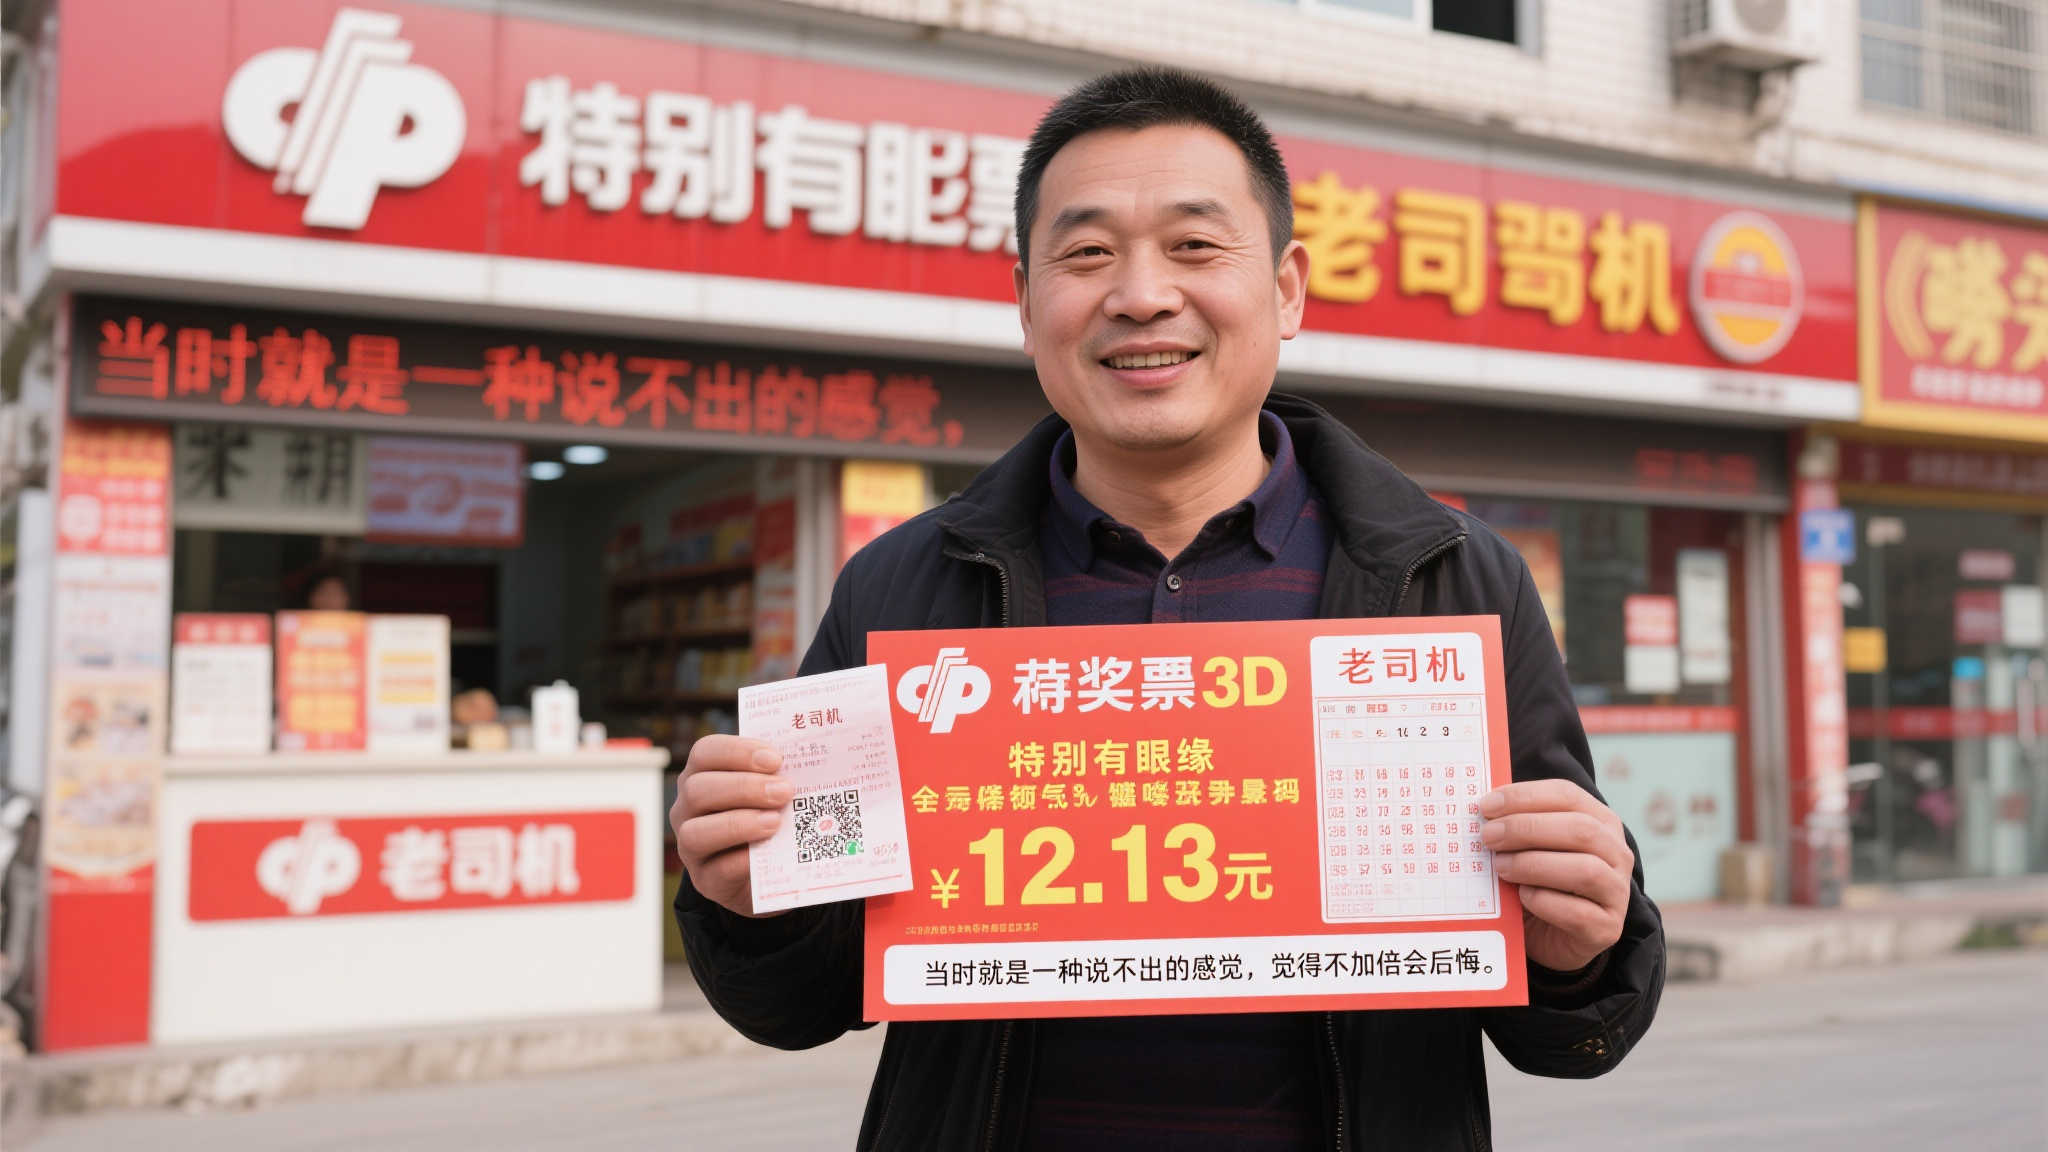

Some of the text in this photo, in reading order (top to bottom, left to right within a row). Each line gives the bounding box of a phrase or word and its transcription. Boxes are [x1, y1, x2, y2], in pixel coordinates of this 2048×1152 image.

[1339, 646, 1465, 684] 老司机
[792, 708, 844, 729] 老司机
[1008, 737, 1214, 778] 特别有眼缘
[379, 823, 580, 900] 老司机
[926, 947, 1493, 986] 当时就是一种说不出的感觉，觉得不加倍会后悔。
